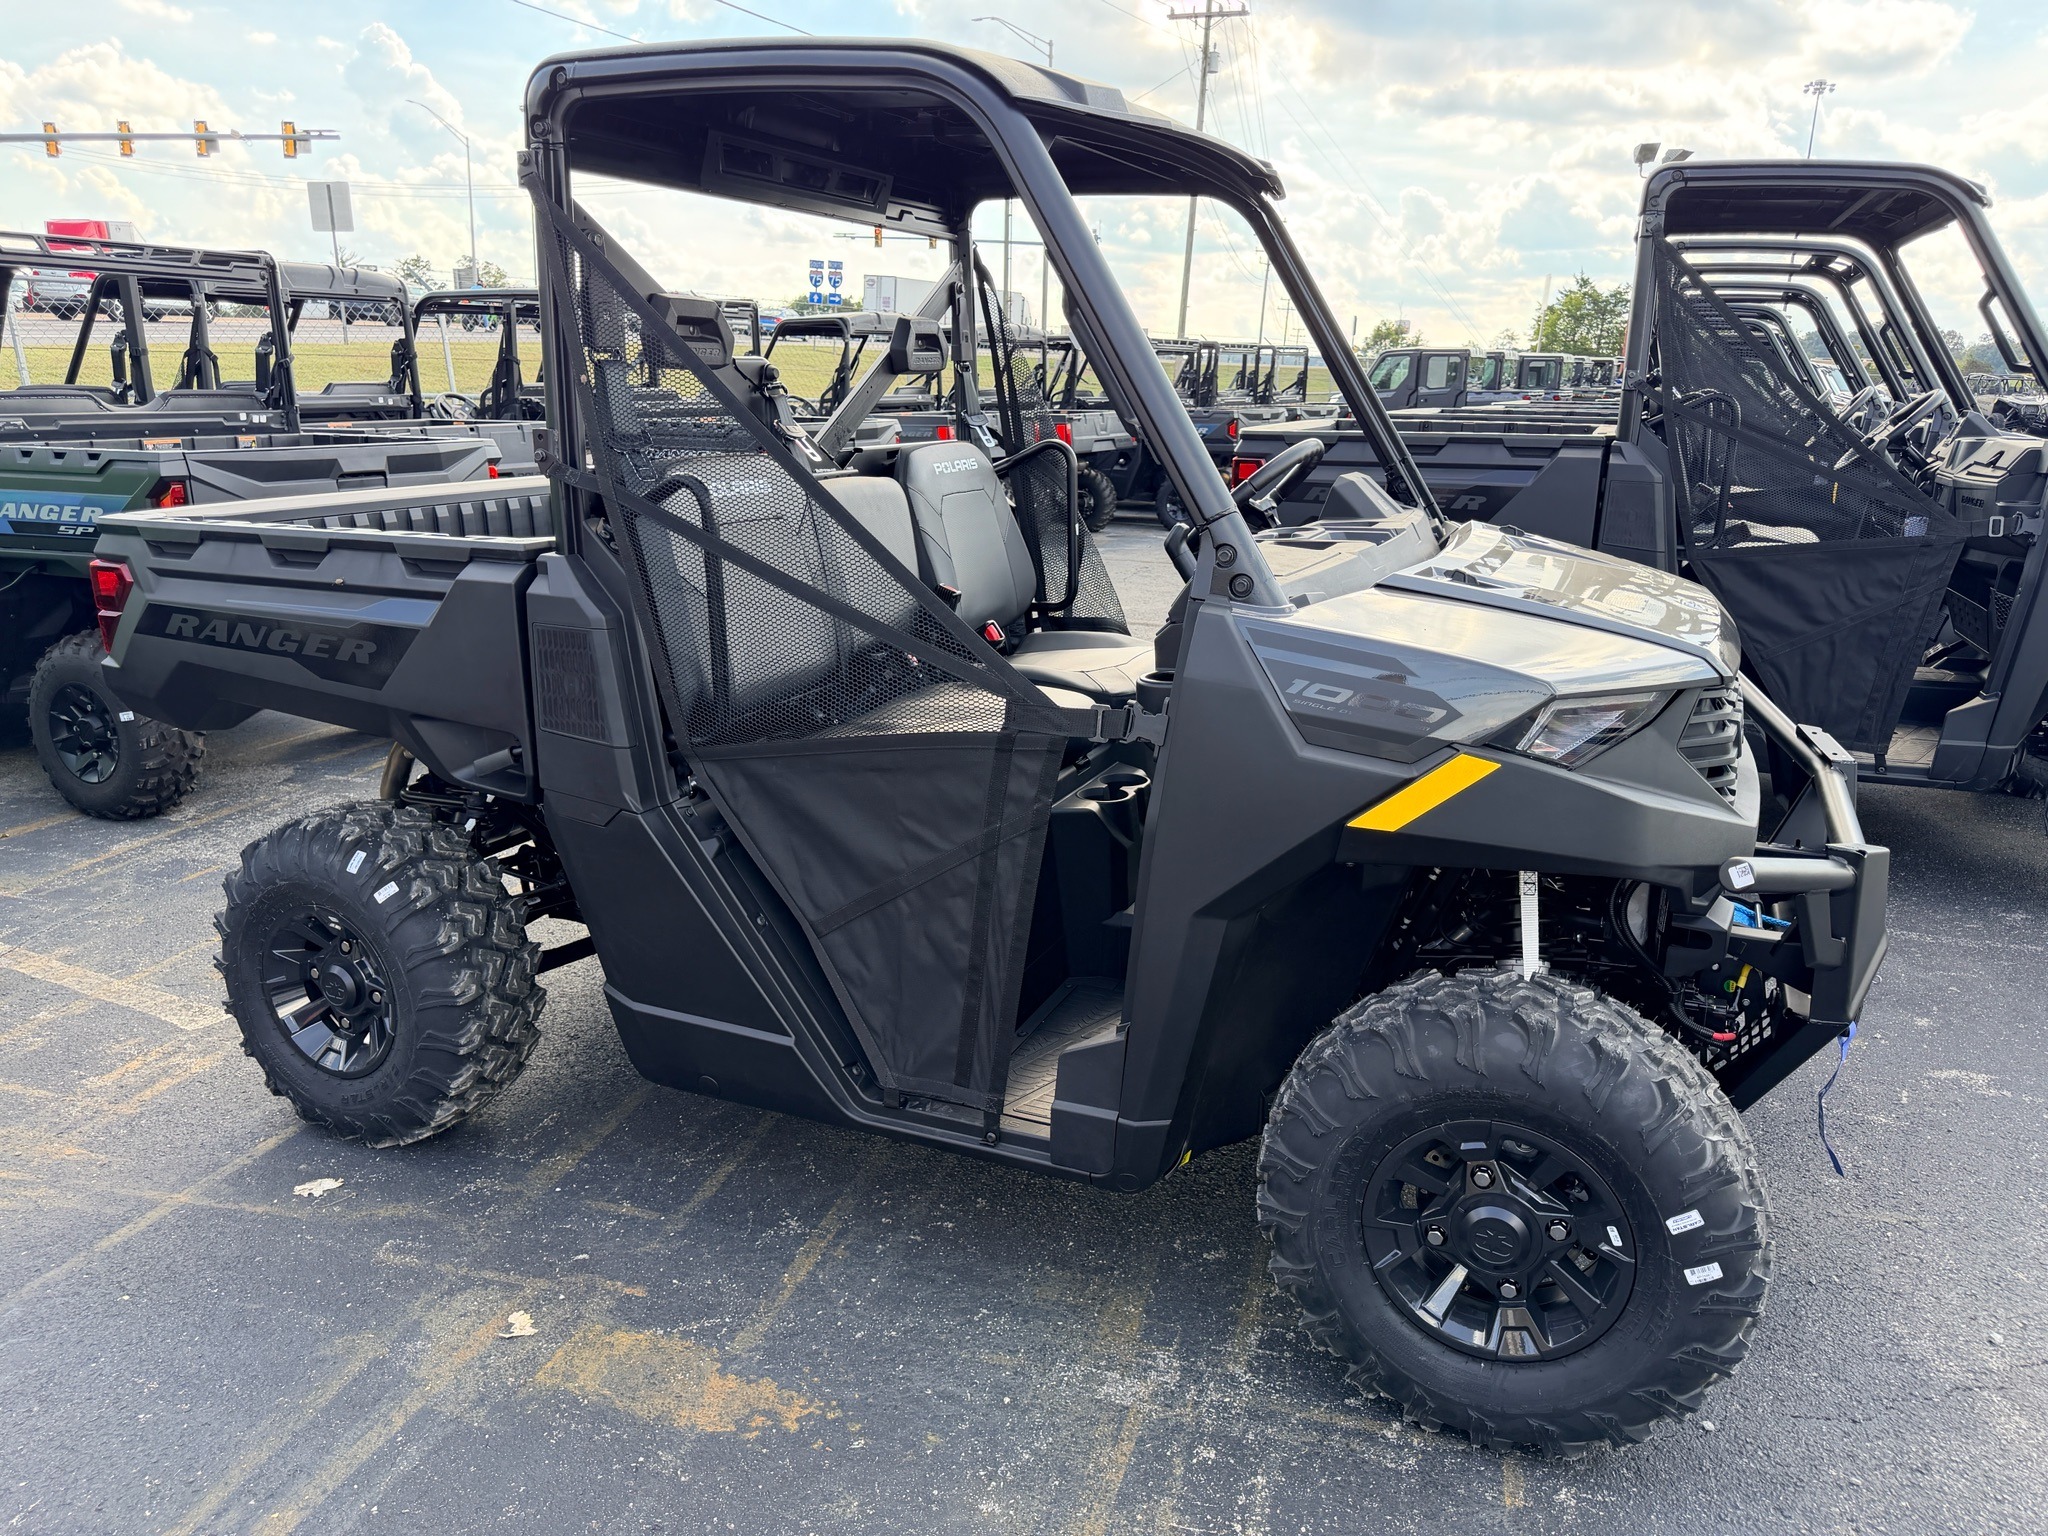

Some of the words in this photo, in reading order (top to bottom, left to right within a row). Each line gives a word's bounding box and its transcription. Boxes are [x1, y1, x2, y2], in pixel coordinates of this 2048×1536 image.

[810, 274, 823, 285] 75
[829, 275, 842, 287] 75
[933, 458, 979, 475] POLARIS
[0, 502, 104, 523] ANGER
[57, 525, 95, 535] SP
[165, 613, 377, 664] RANGER
[1292, 699, 1336, 712] SINGLE
